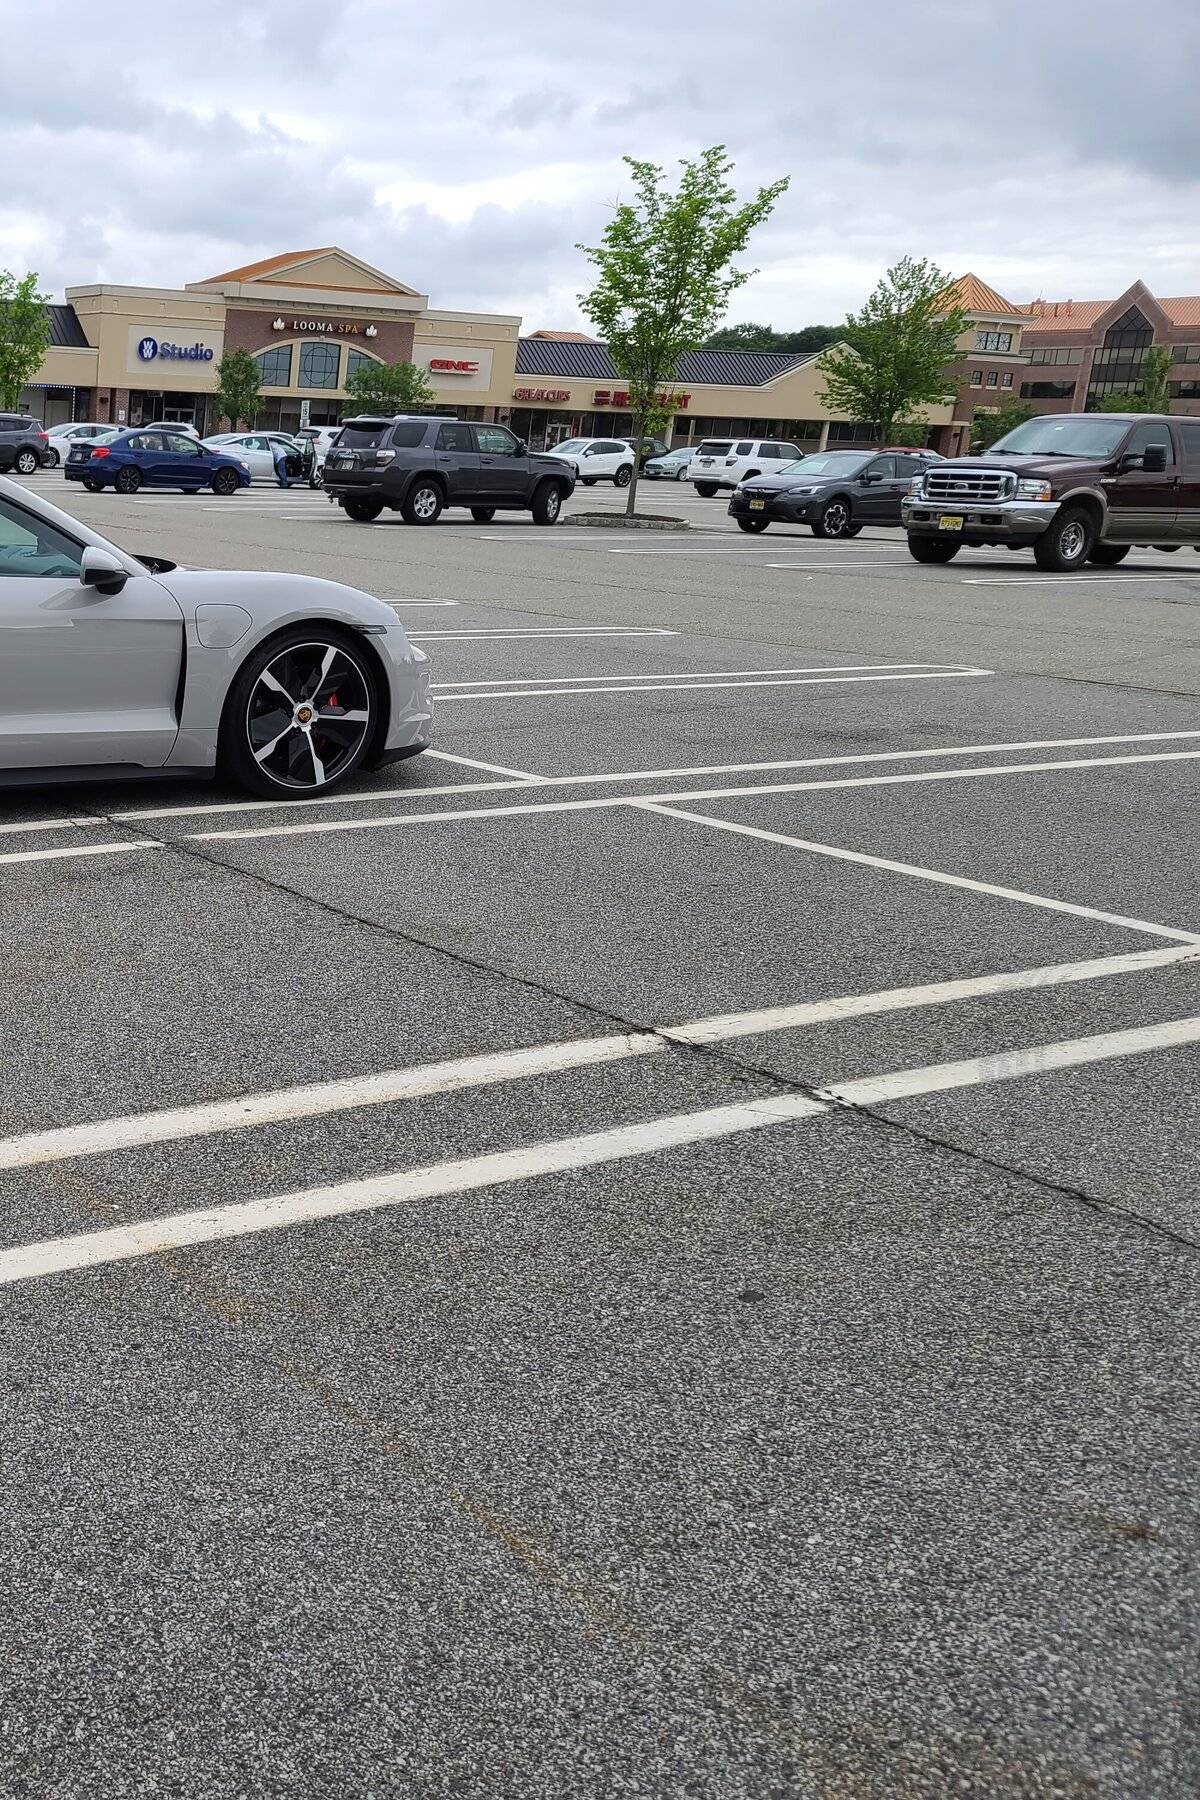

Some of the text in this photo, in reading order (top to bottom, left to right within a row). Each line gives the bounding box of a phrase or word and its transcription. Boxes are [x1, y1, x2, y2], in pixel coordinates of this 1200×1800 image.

[293, 320, 358, 334] LOOMA SPA
[160, 342, 214, 360] Studio
[430, 359, 479, 371] GNC
[514, 387, 547, 401] GREAT
